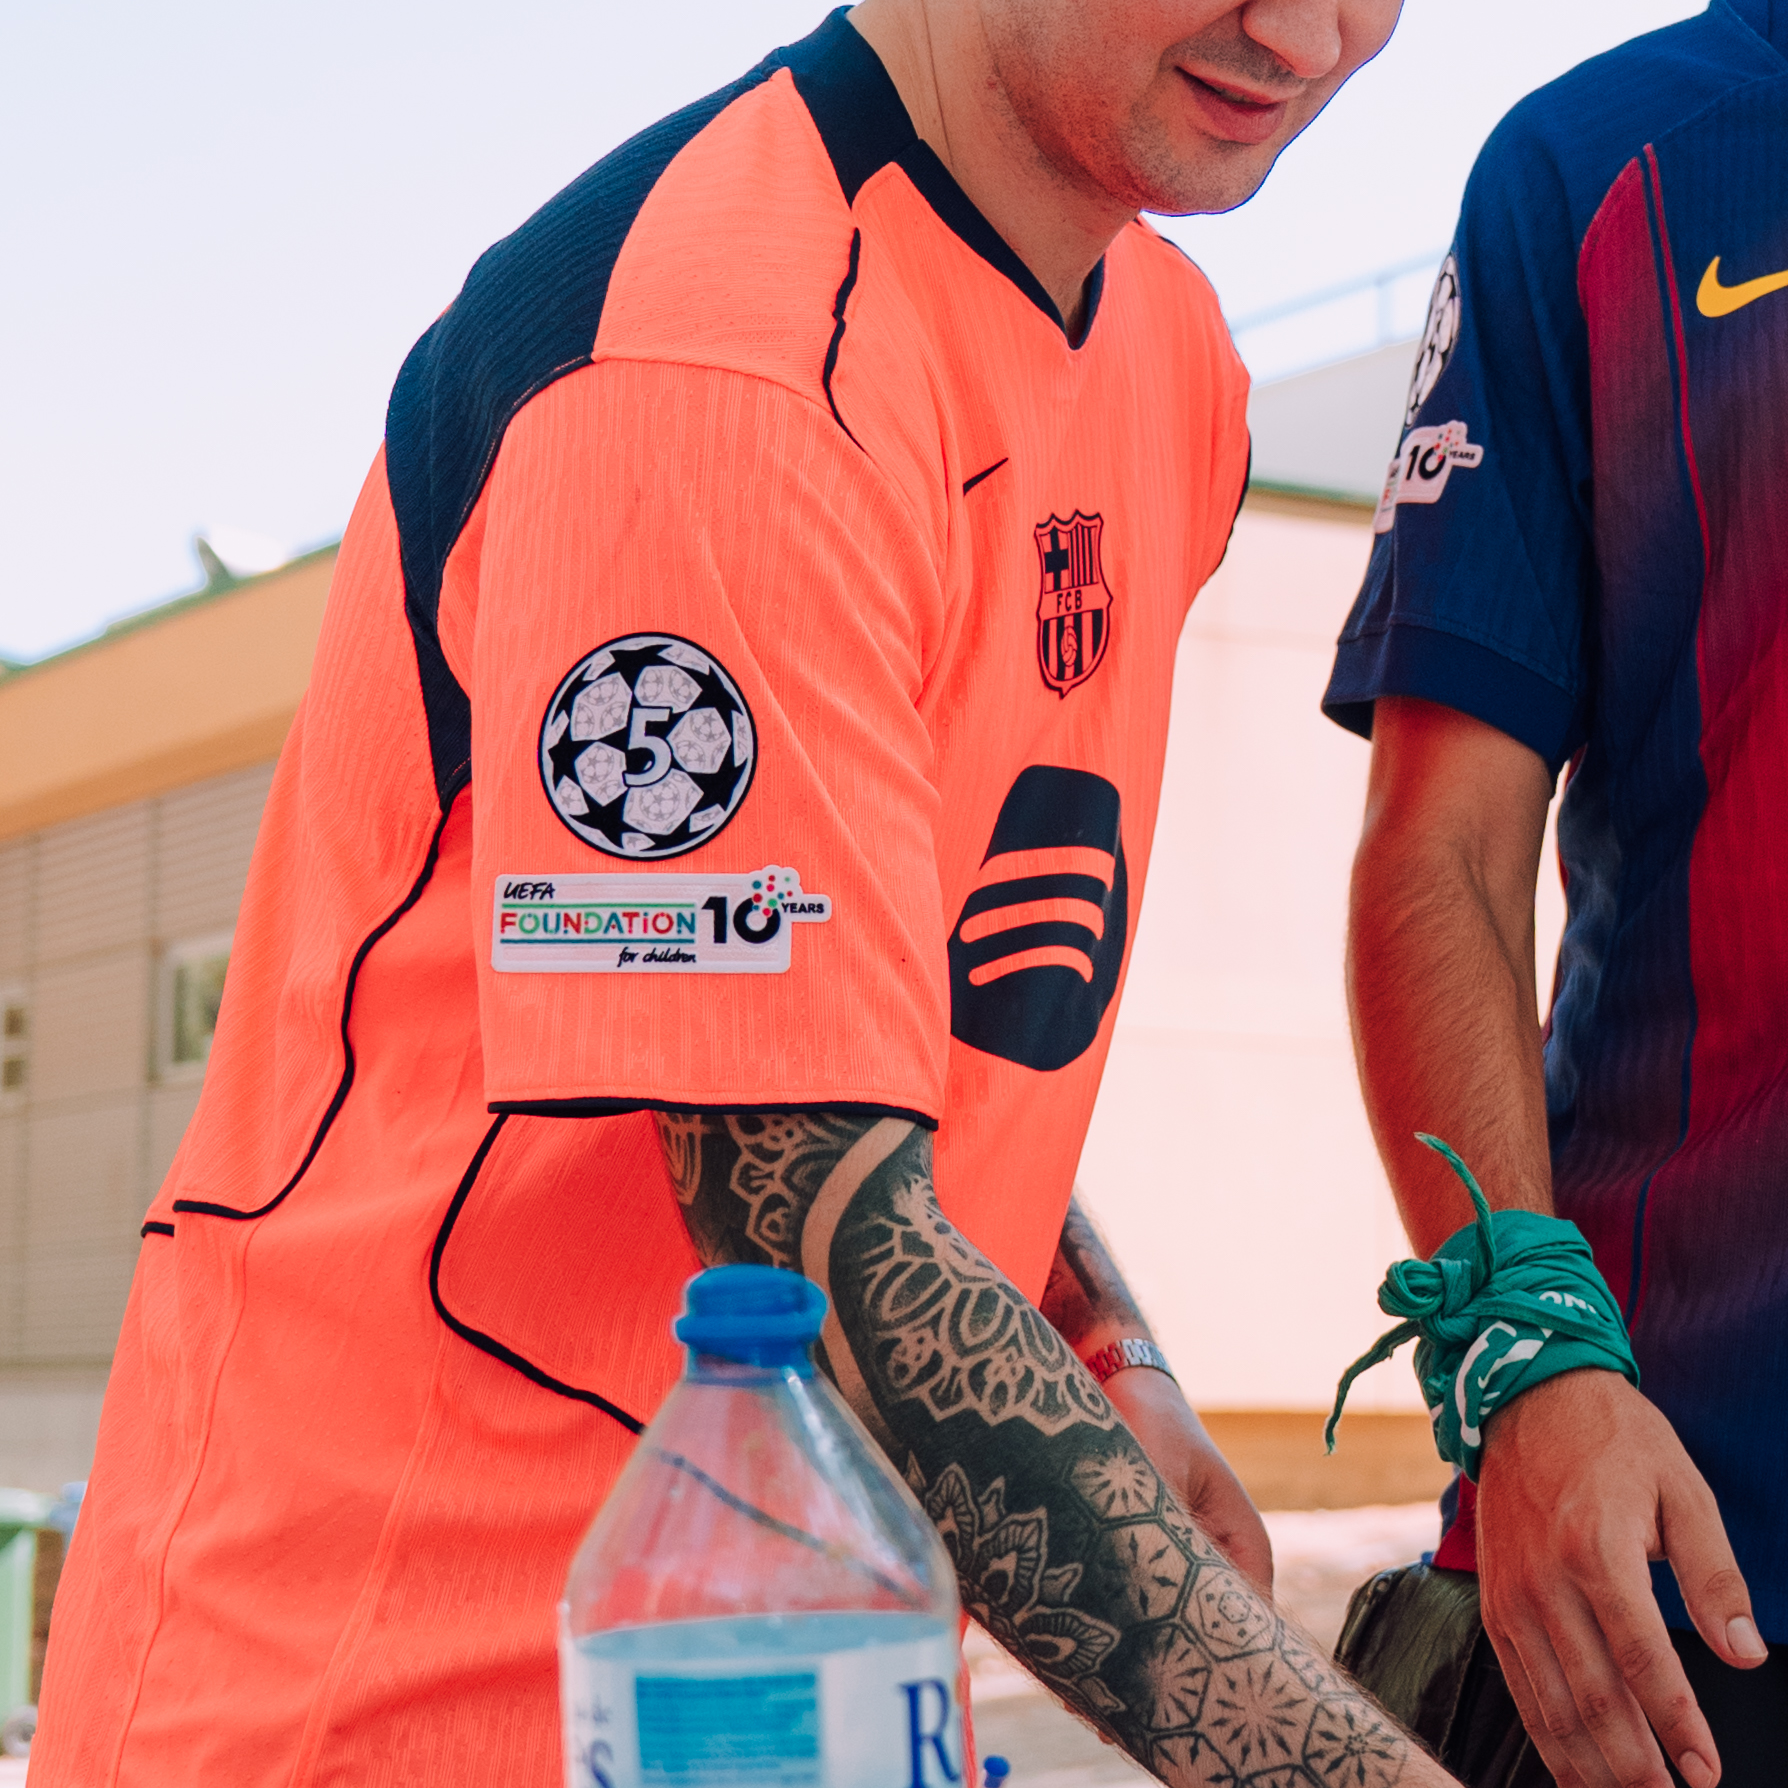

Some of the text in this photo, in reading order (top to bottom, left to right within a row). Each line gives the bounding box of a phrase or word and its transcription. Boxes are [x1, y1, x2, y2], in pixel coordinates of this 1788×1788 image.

[1405, 444, 1476, 481] 10 YEARS
[1057, 590, 1082, 613] FCB
[623, 707, 673, 787] 5
[503, 882, 556, 900] UEFA
[500, 911, 696, 935] FOUNDATION
[701, 896, 825, 944] 10 YEARS
[616, 947, 697, 968] for children
